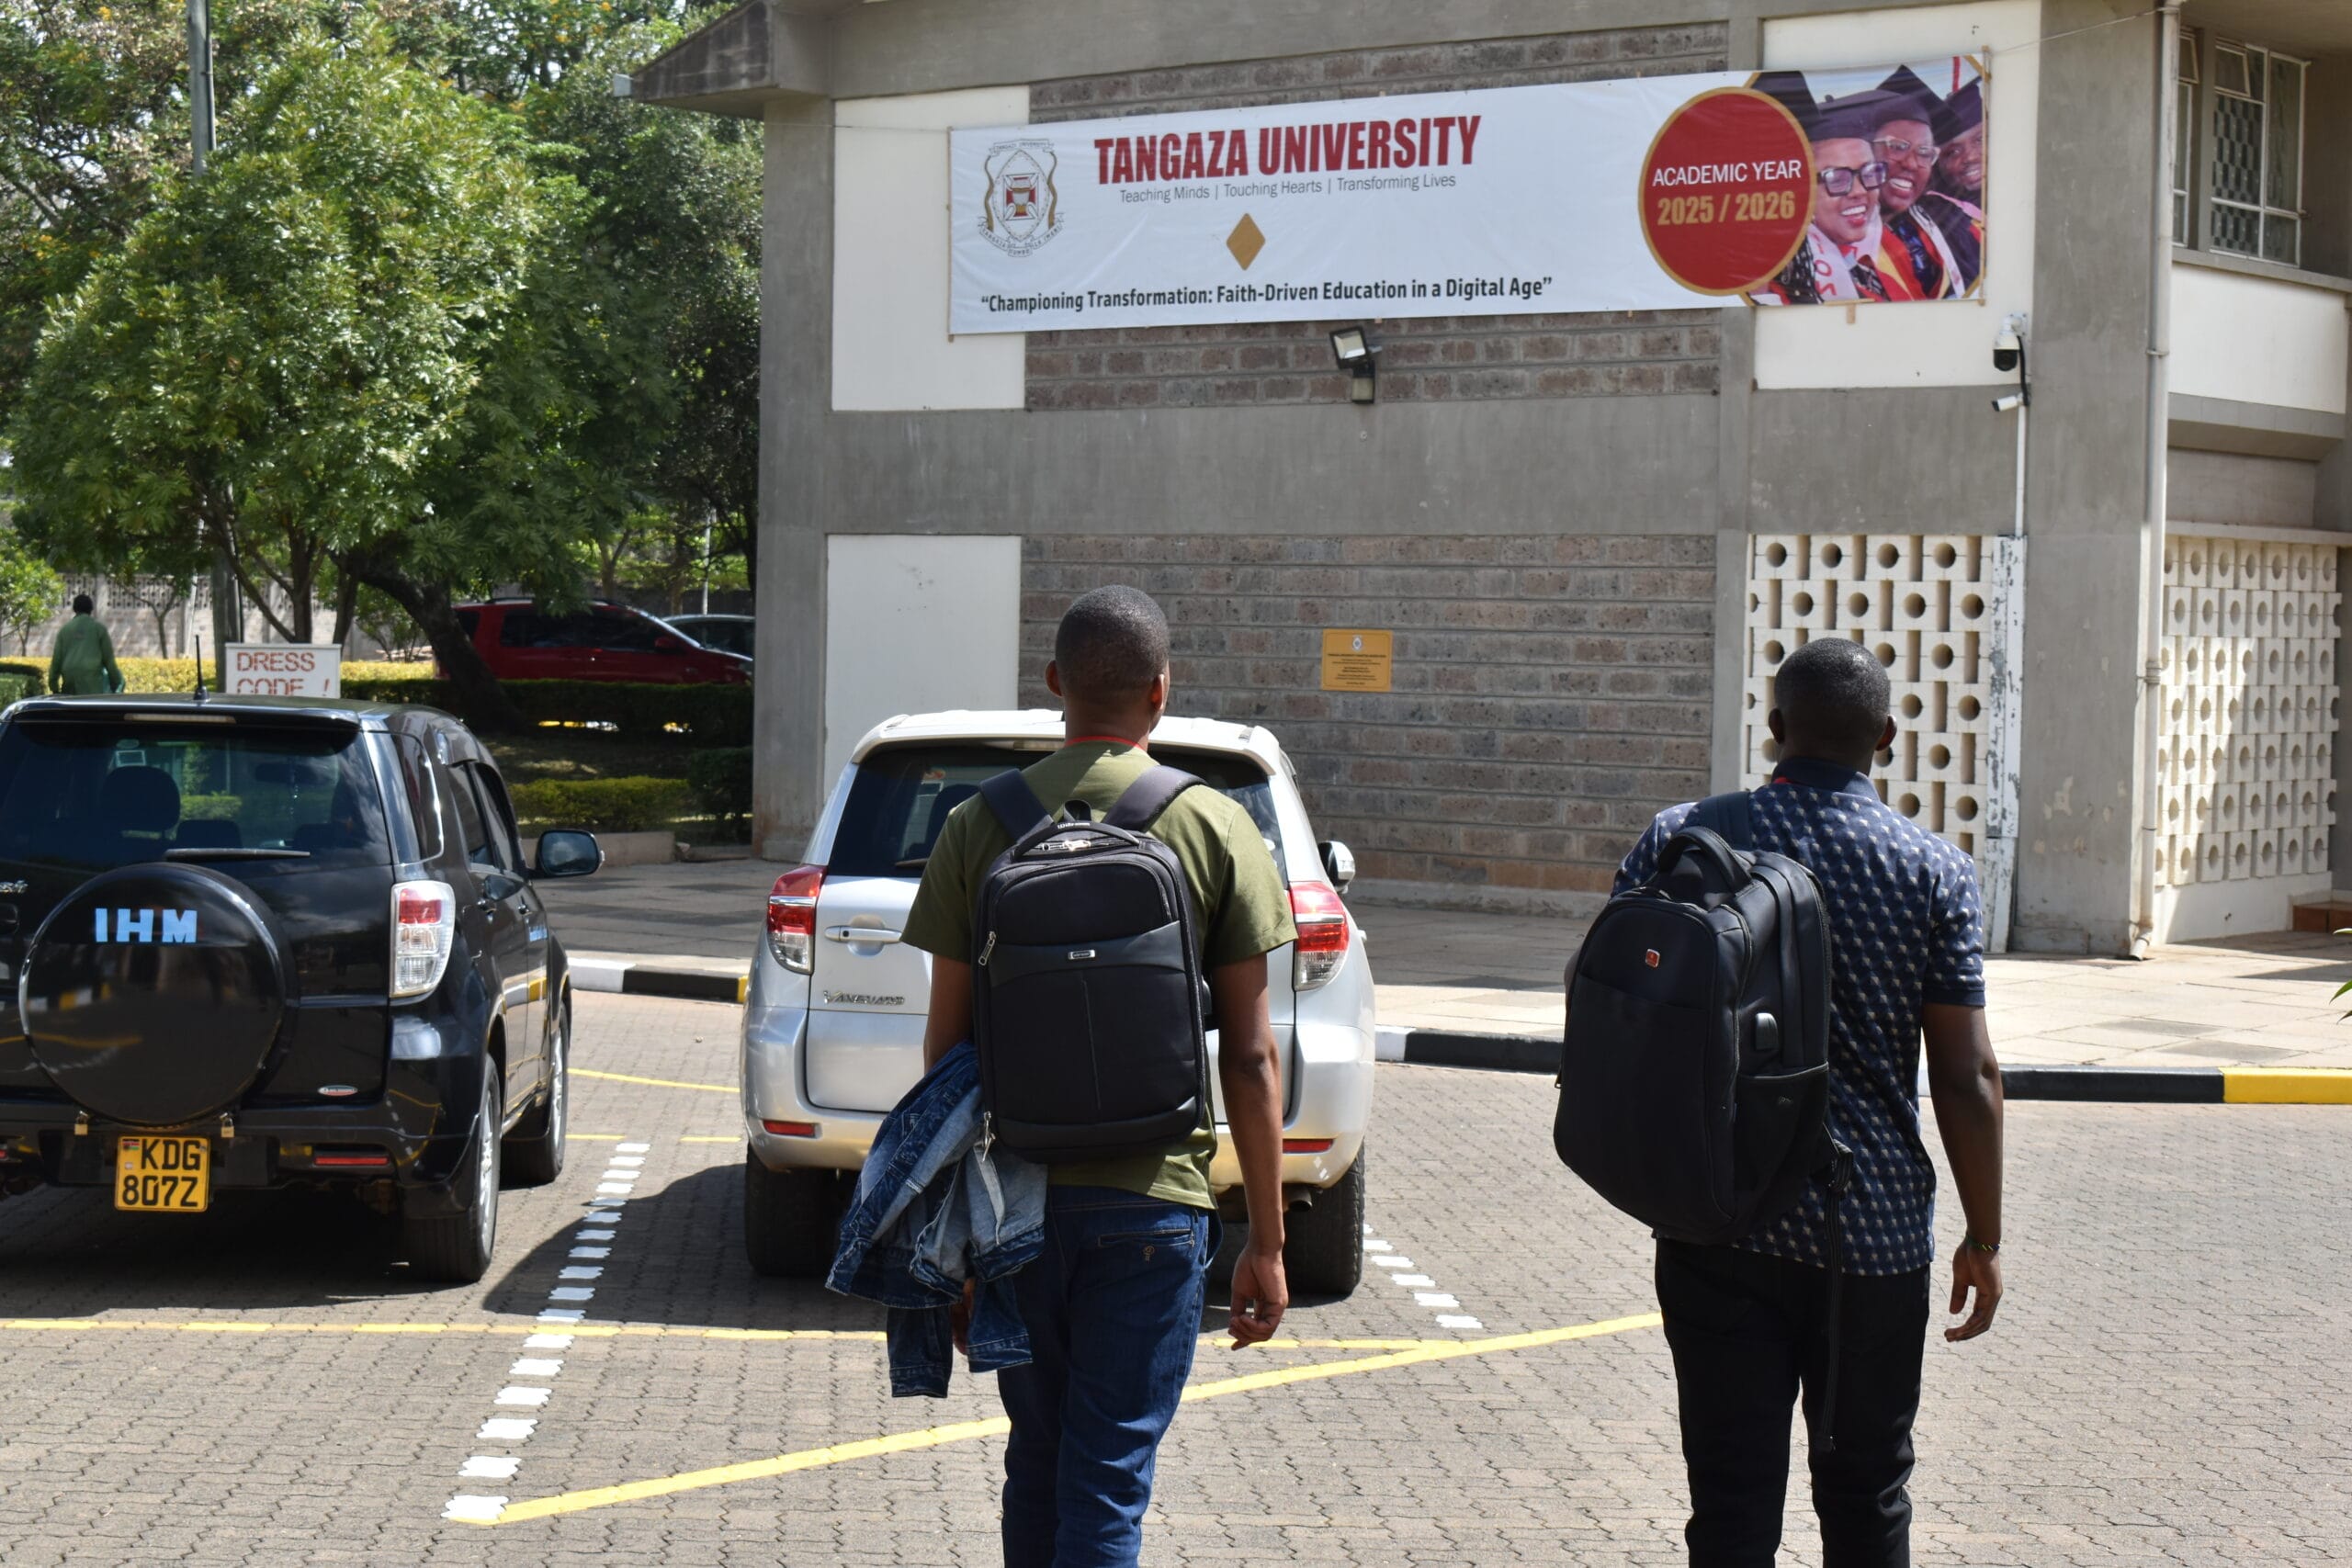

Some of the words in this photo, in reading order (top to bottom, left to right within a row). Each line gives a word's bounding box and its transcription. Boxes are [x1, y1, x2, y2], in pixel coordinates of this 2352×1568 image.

[1094, 130, 1249, 184] TANGAZA
[1259, 115, 1481, 175] UNIVERSITY
[1120, 186, 1170, 203] Teaching
[1174, 185, 1210, 199] Minds
[1224, 182, 1278, 197] Touching
[1281, 179, 1322, 194] Hearts
[1337, 175, 1419, 191] Transforming
[1423, 173, 1456, 187] Lives
[1652, 163, 1747, 186] ACADEMIC
[1751, 159, 1802, 181] YEAR
[1657, 195, 1714, 226] 2025
[1735, 190, 1795, 221] 2026
[981, 292, 1083, 313] “Championing
[1087, 287, 1213, 308] Transformation:
[1217, 282, 1317, 303] Faith-Driven
[1323, 280, 1405, 299] Education
[1412, 279, 1427, 297] in
[1431, 281, 1441, 297] a
[1446, 276, 1504, 300] Digital
[1510, 276, 1552, 300] Age”
[236, 651, 315, 671] DRESS
[95, 908, 198, 942] IHM
[141, 1139, 200, 1170] KDG
[122, 1175, 198, 1207] 807Z
